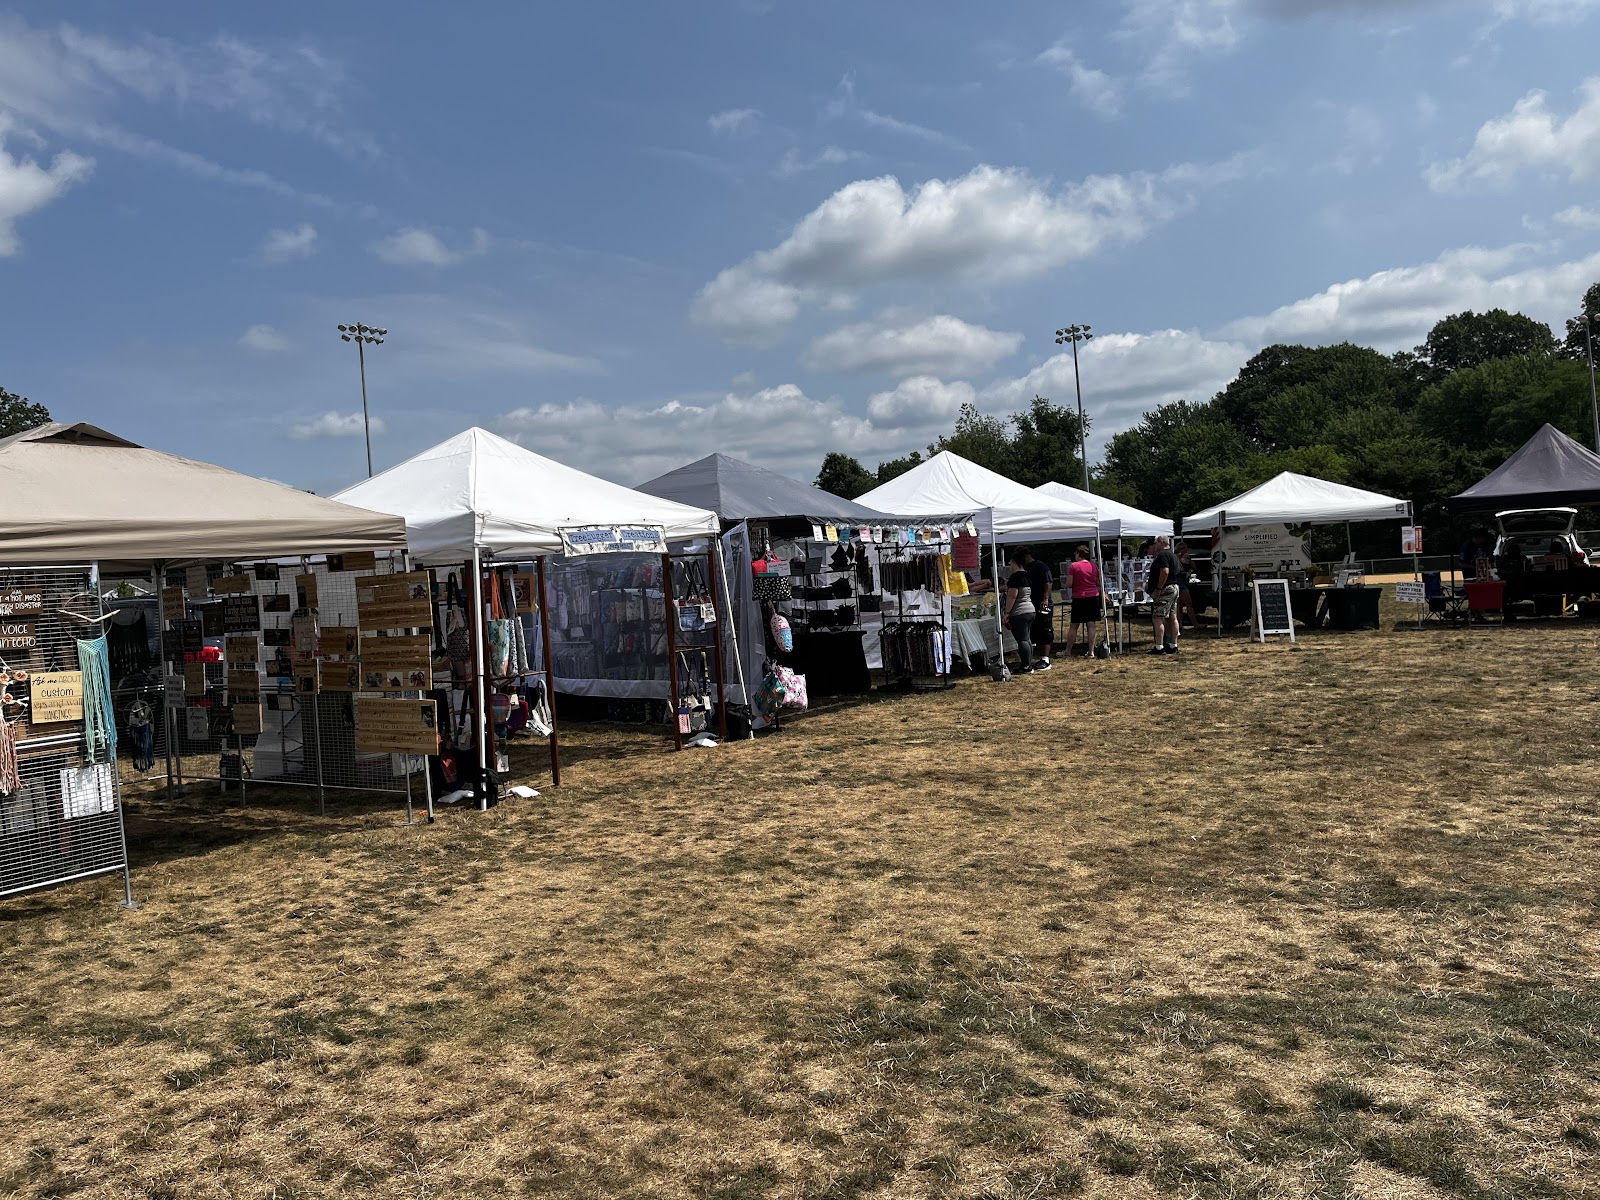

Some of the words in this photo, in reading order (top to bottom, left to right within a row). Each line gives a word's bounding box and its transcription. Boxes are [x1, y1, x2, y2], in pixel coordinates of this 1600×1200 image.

[1244, 533, 1278, 541] SIMPLIFIED
[24, 593, 41, 602] MESS
[1, 624, 28, 635] VOICE
[12, 637, 36, 648] ECHO
[32, 676, 46, 686] Ask
[58, 674, 81, 683] ABOUT
[41, 687, 74, 698] custom
[66, 697, 83, 706] wall
[44, 708, 73, 721] HANGINGS
